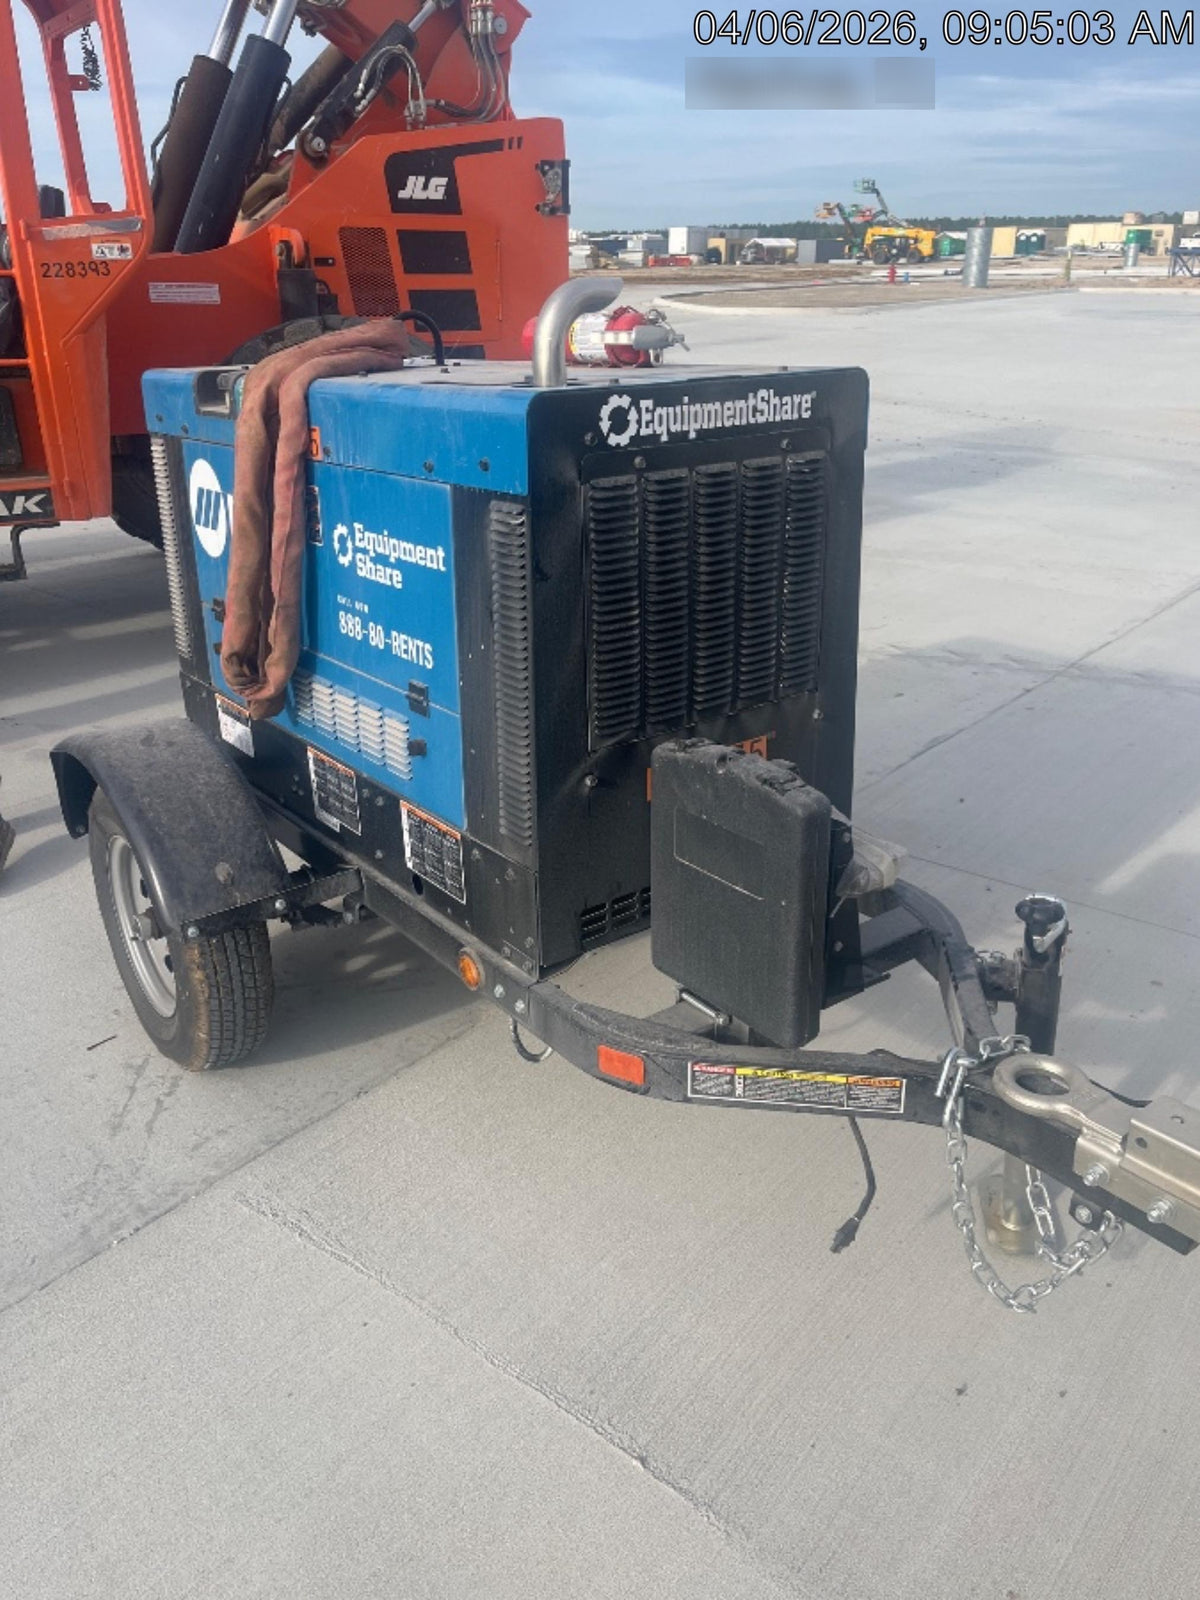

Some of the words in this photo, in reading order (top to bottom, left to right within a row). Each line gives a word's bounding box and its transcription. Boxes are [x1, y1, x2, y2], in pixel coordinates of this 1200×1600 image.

[397, 175, 449, 200] JLG
[40, 261, 111, 278] 228393
[639, 389, 812, 443] EquipmentShare
[353, 522, 447, 571] Equipment
[355, 553, 403, 589] Share
[338, 610, 434, 669] 888-80-RENTS
